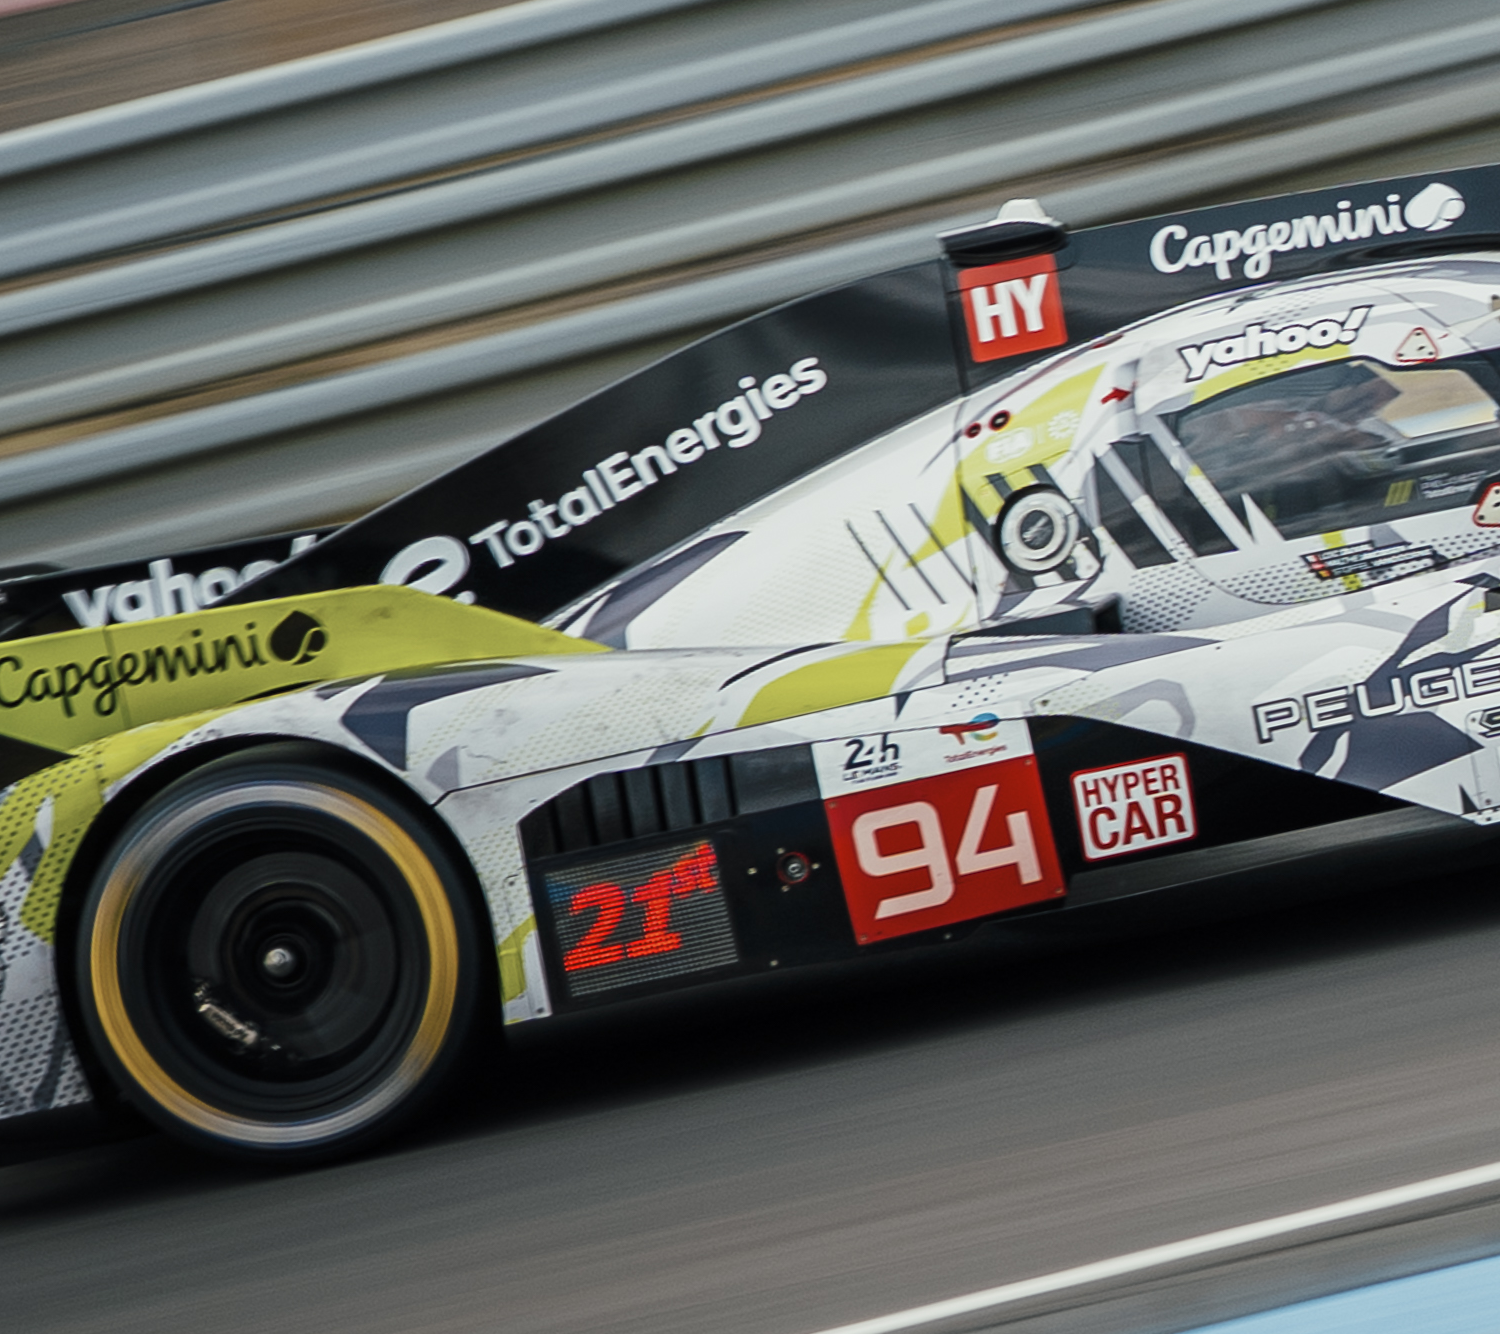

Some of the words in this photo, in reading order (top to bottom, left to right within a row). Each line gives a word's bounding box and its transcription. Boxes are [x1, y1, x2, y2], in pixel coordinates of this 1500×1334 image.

[1150, 193, 1404, 281] Capgemini
[970, 273, 1049, 344] HY
[1177, 304, 1375, 383] yahoo!
[469, 355, 829, 569] TotalEnergies
[1080, 760, 1180, 807] HYPER
[1087, 793, 1188, 851] CAR
[850, 783, 1043, 921] 94
